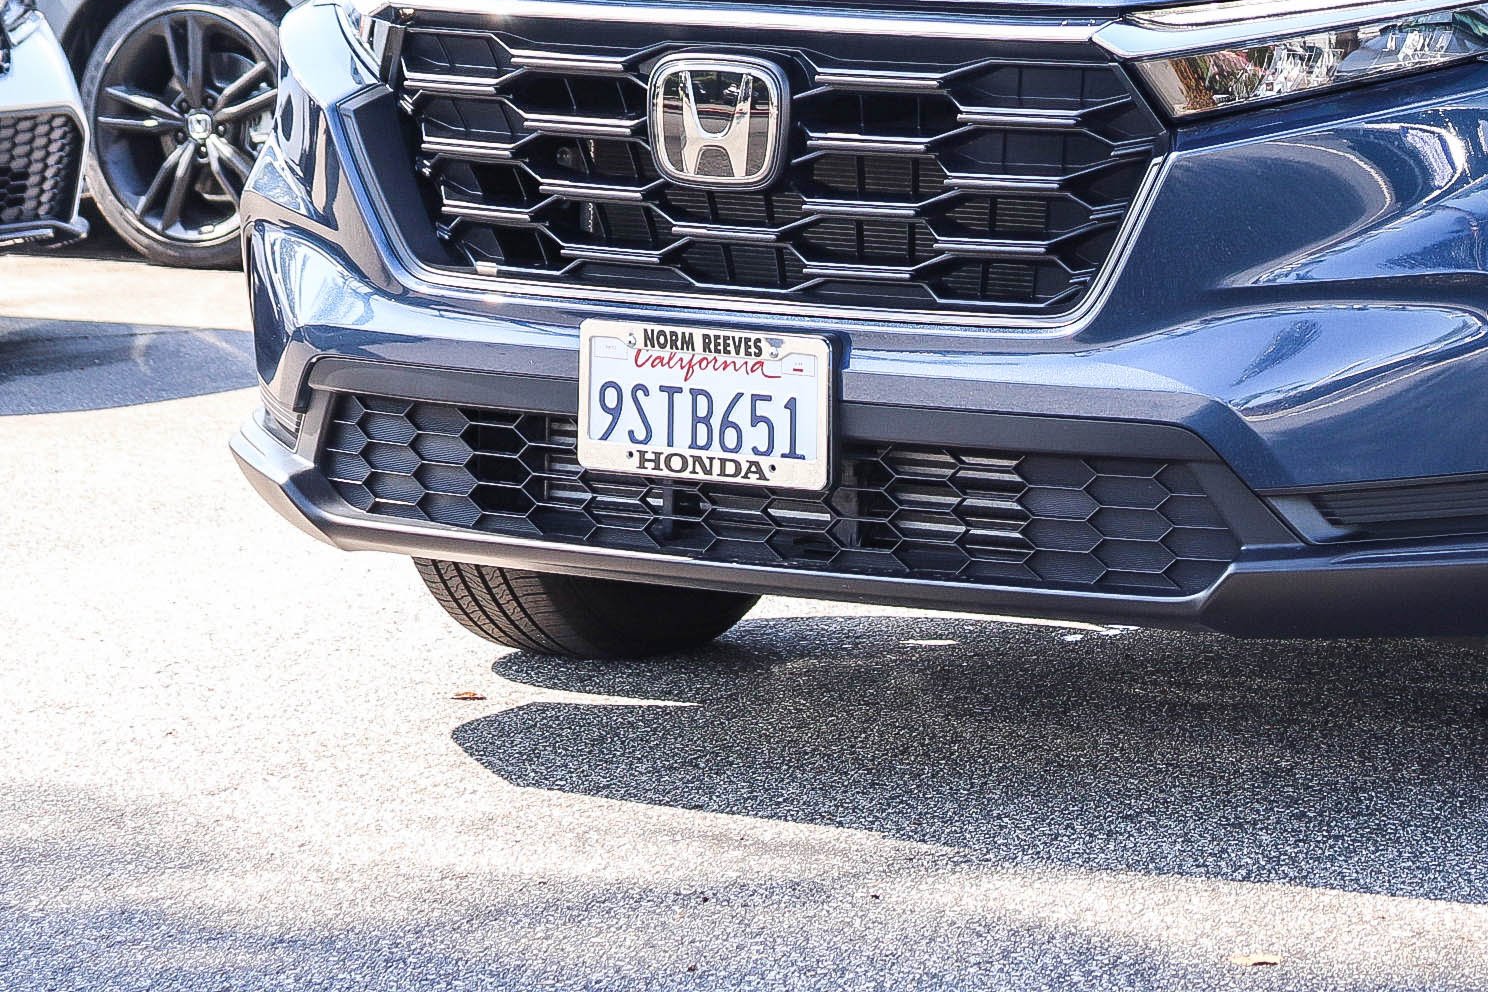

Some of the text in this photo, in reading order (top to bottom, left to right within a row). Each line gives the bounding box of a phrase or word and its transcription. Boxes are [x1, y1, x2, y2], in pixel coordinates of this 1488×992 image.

[643, 328, 763, 358] NORM REEVES
[634, 349, 781, 382] California
[599, 380, 806, 461] 9STB651
[636, 450, 770, 482] HONDA
